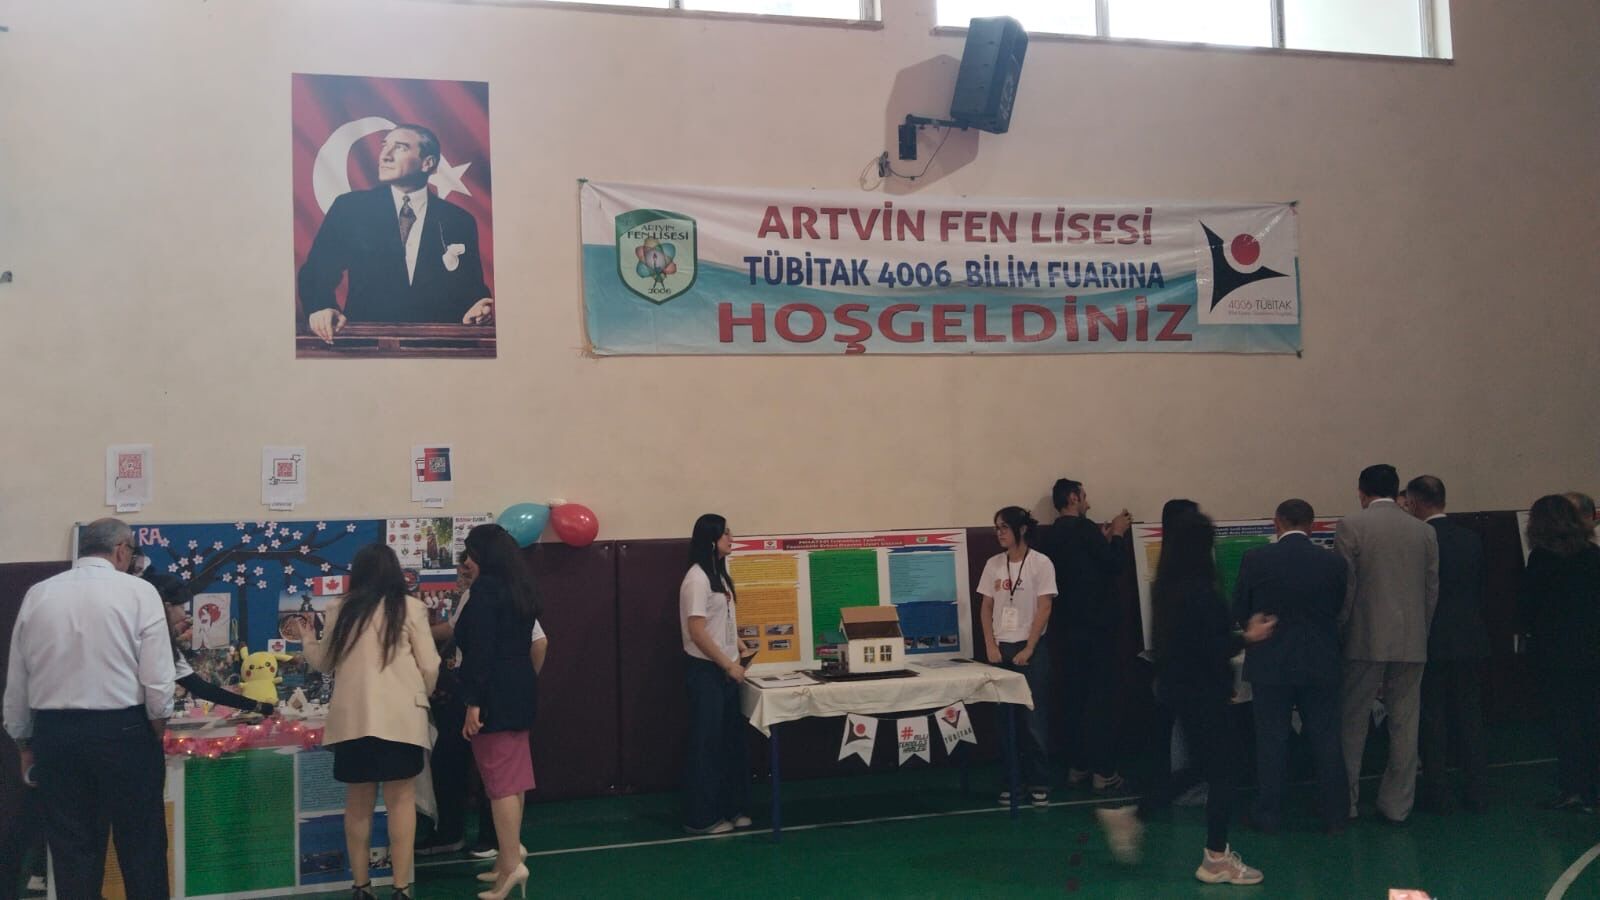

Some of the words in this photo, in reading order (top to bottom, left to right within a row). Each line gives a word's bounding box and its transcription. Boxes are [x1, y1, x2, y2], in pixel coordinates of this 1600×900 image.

[757, 201, 925, 242] ARTVİN
[939, 210, 1019, 244] FEN
[1031, 206, 1153, 246] LİSESİ
[743, 250, 870, 287] TÜBİTAK
[877, 259, 952, 288] 4006
[965, 254, 1039, 289] BİLİM
[1047, 259, 1166, 289] FUARINA
[717, 295, 1193, 355] HOŞGELDİNİZ
